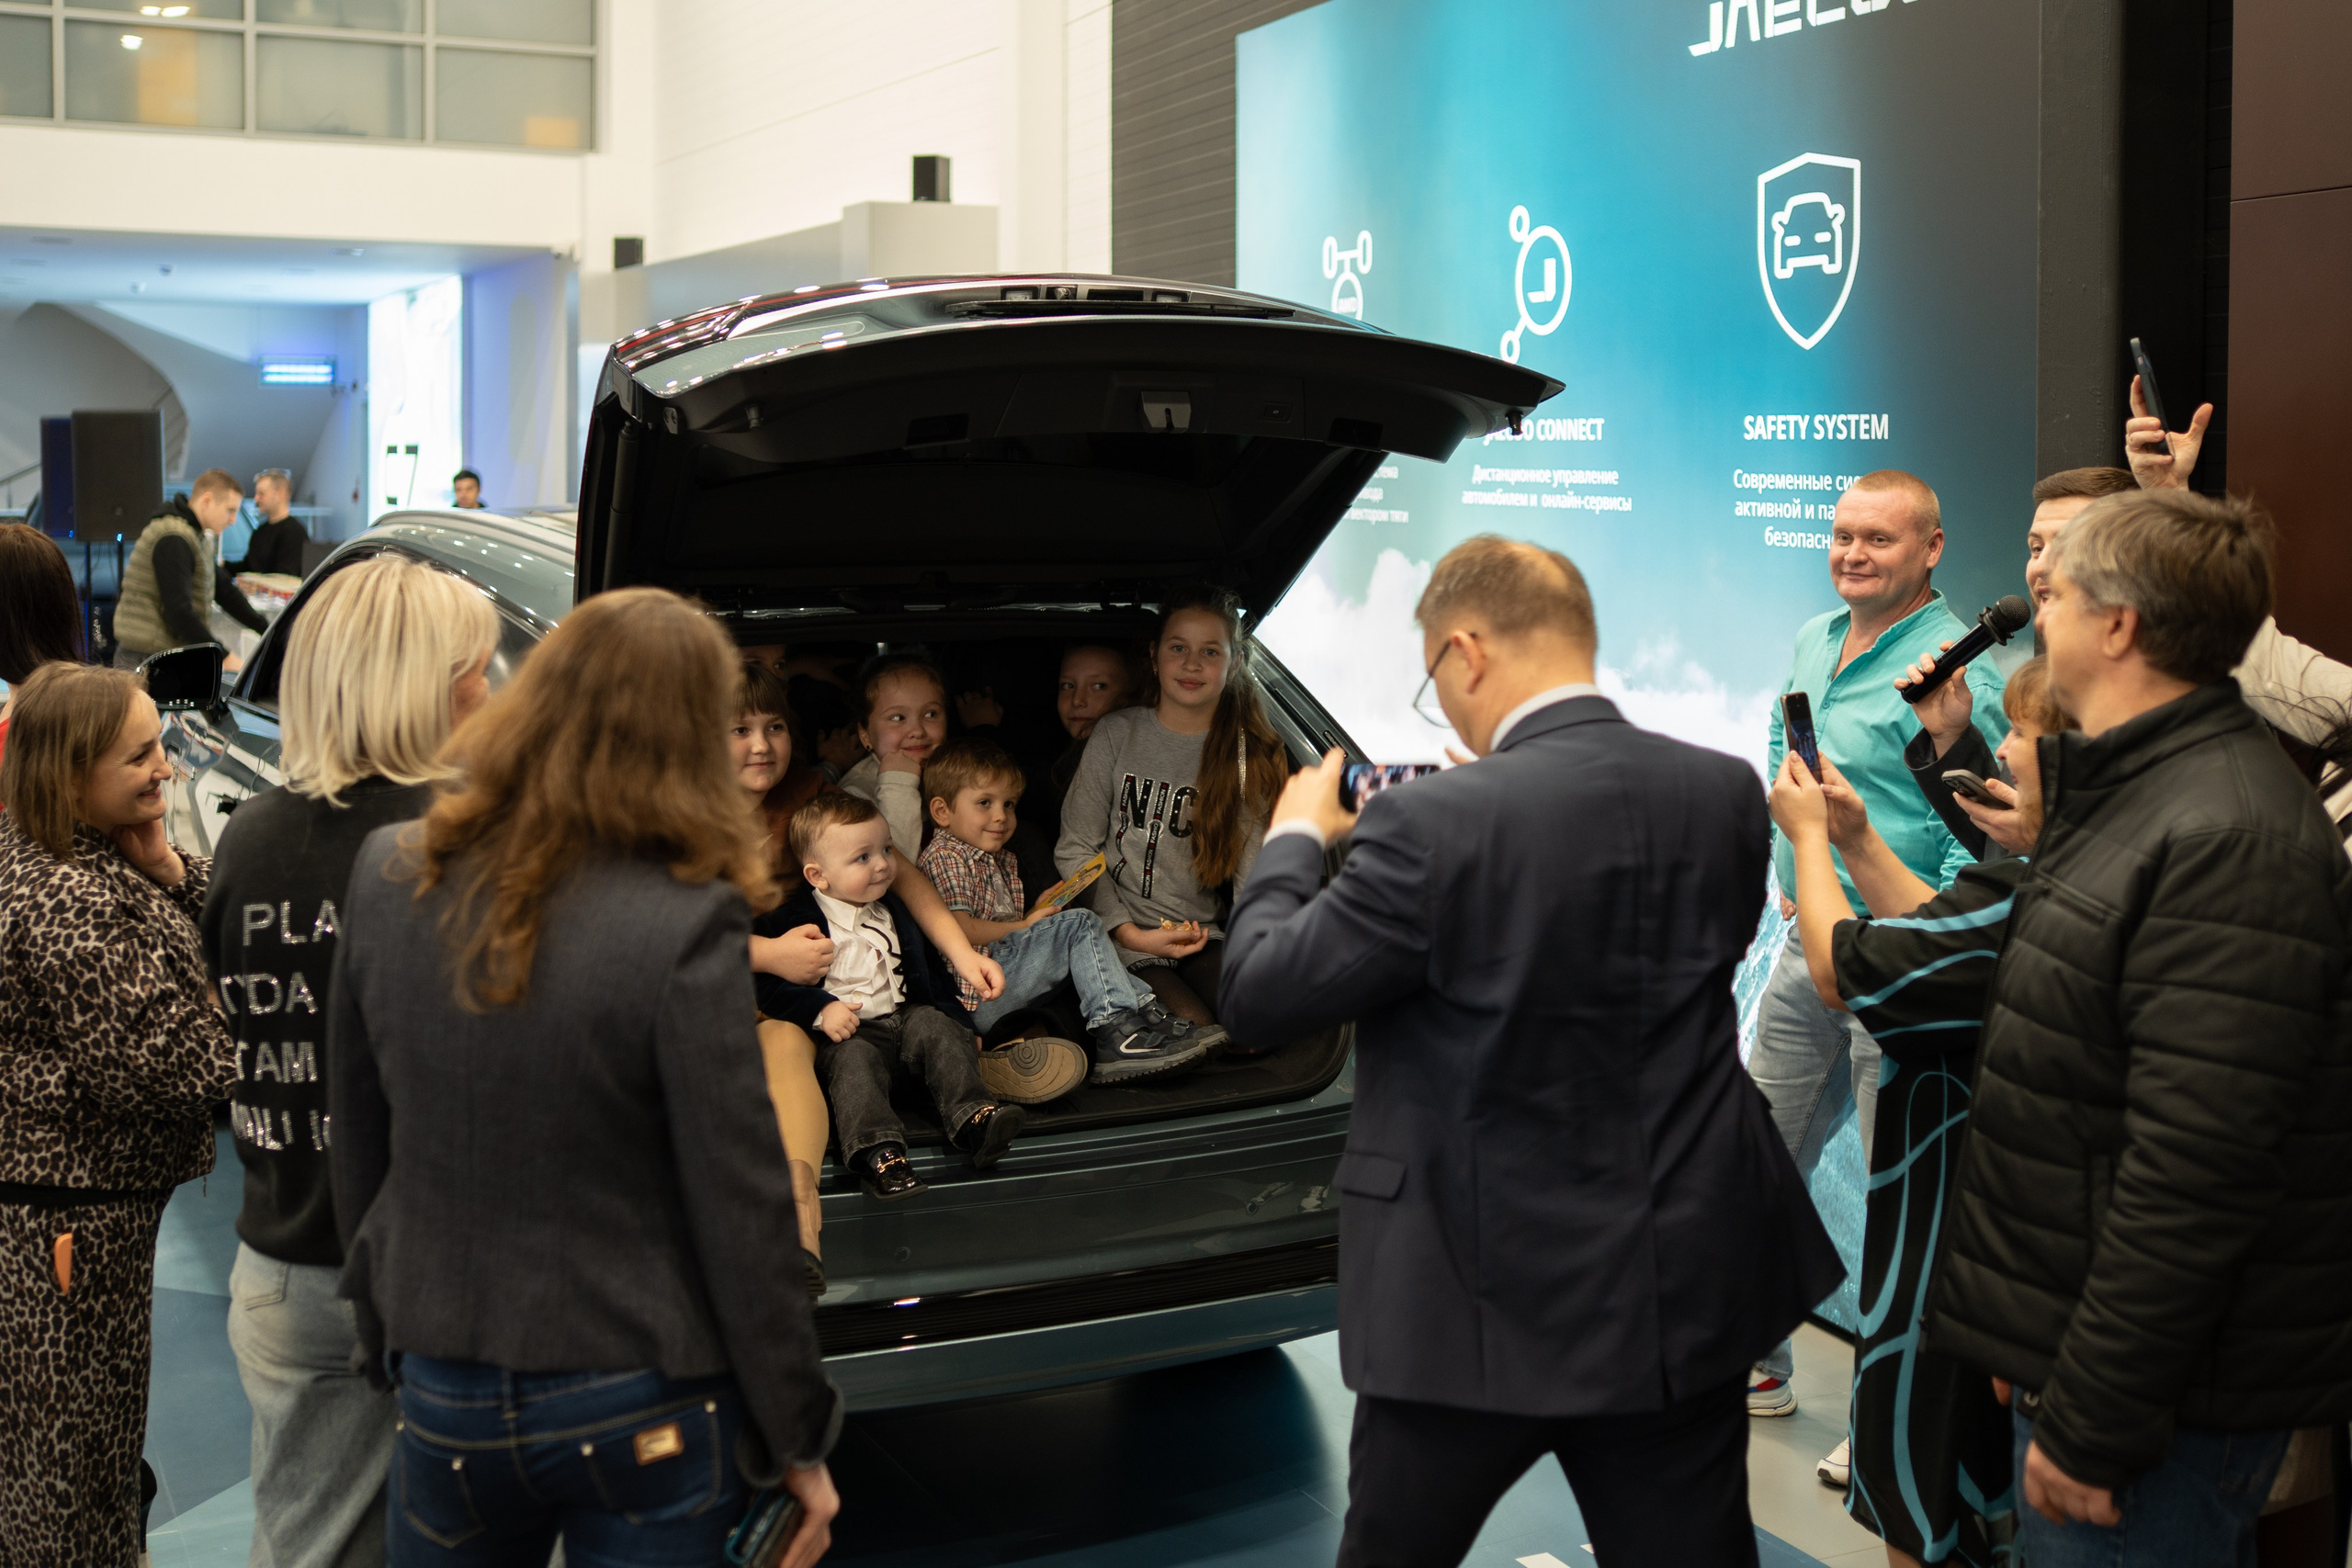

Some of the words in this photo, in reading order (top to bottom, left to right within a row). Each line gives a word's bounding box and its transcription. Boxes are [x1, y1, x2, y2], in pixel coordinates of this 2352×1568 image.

[1688, 0, 1918, 57] JAEC
[1536, 417, 1605, 441] CONNECT
[1744, 414, 1810, 440] SAFETY
[1814, 413, 1889, 440] SYSTEM
[1472, 464, 1552, 485] Дистанционное
[1552, 468, 1619, 488] управление
[1733, 468, 1832, 494] Современные
[1462, 488, 1528, 507] автомобилем
[1530, 493, 1538, 507] и
[1541, 491, 1633, 514] онлайн-сервисы
[1735, 498, 1801, 519] активной
[1805, 504, 1815, 520] и
[1818, 504, 1836, 521] па
[1764, 525, 1834, 549] безопасн
[1120, 773, 1199, 838] NIC
[1122, 782, 1131, 807] FASHION
[1157, 789, 1166, 814] FASHION
[1146, 849, 1154, 870] FASHION
[243, 898, 342, 946] PLA
